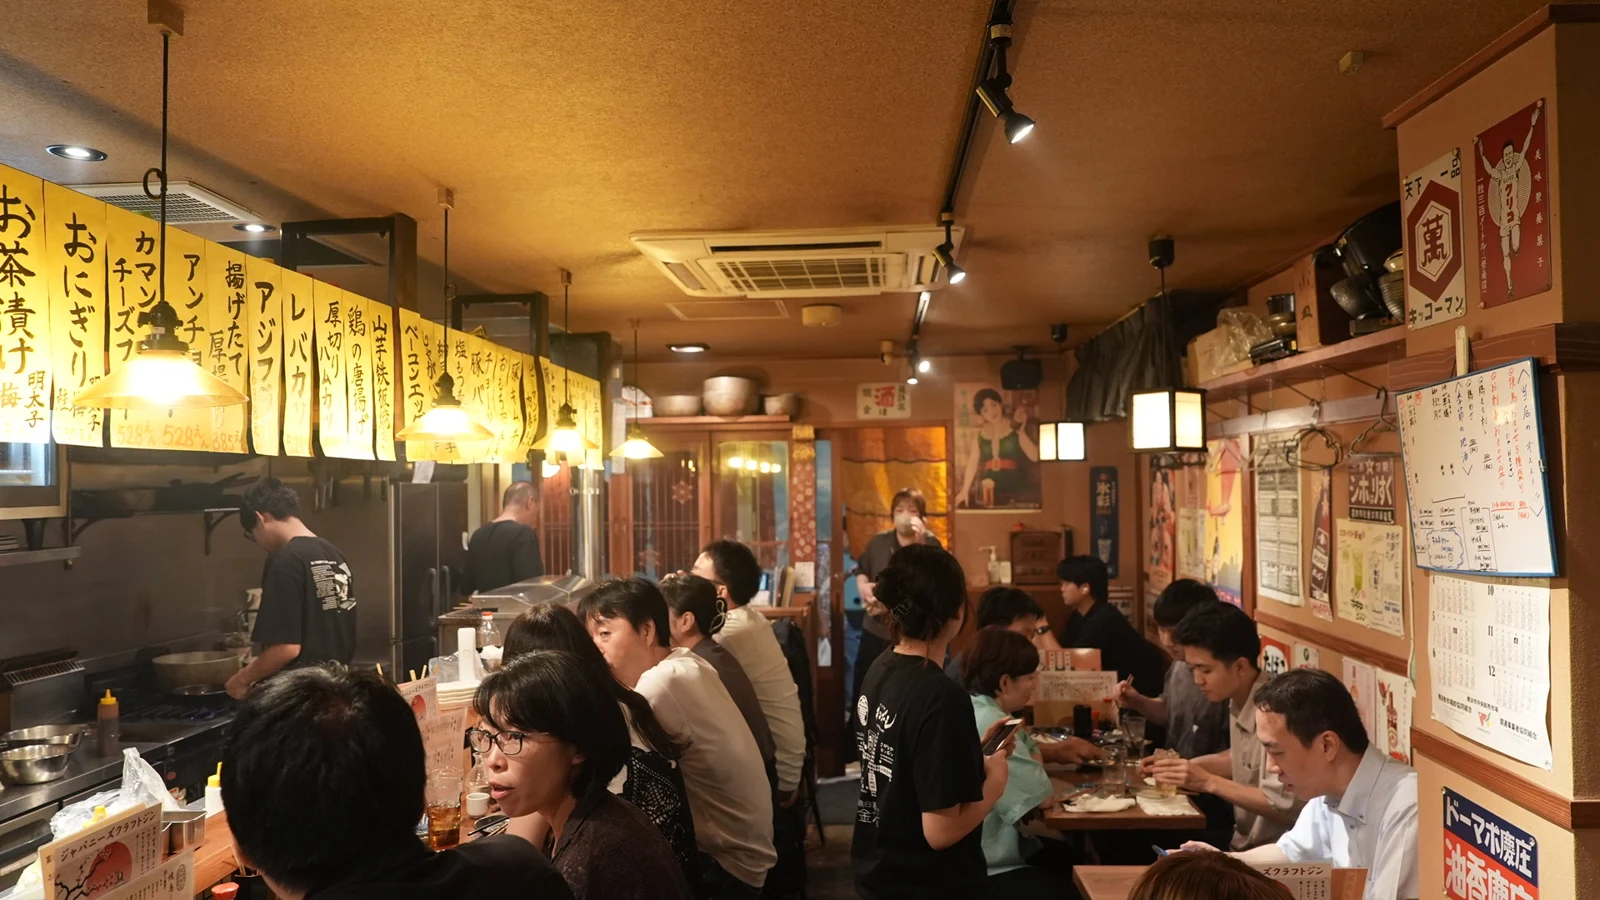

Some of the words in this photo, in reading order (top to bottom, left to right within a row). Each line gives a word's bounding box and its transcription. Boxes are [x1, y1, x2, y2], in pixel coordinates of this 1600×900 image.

[1405, 176, 1423, 200] 天下
[1505, 183, 1515, 224] グリコ
[1422, 213, 1447, 268] 萬
[0, 184, 37, 374] お茶漬け
[64, 213, 97, 387] おにぎり
[225, 260, 246, 376] 揚げたて
[1409, 296, 1464, 325] キッコーマン
[325, 301, 342, 378] 厚切り
[347, 304, 370, 435] 鶏の唐揚げ
[24, 370, 47, 428] 明太子
[1487, 585, 1495, 596] 10
[1488, 665, 1496, 677] 12
[61, 811, 156, 862] ジャパニーズクラフトジン
[1263, 866, 1324, 876] ズクラフトジン
